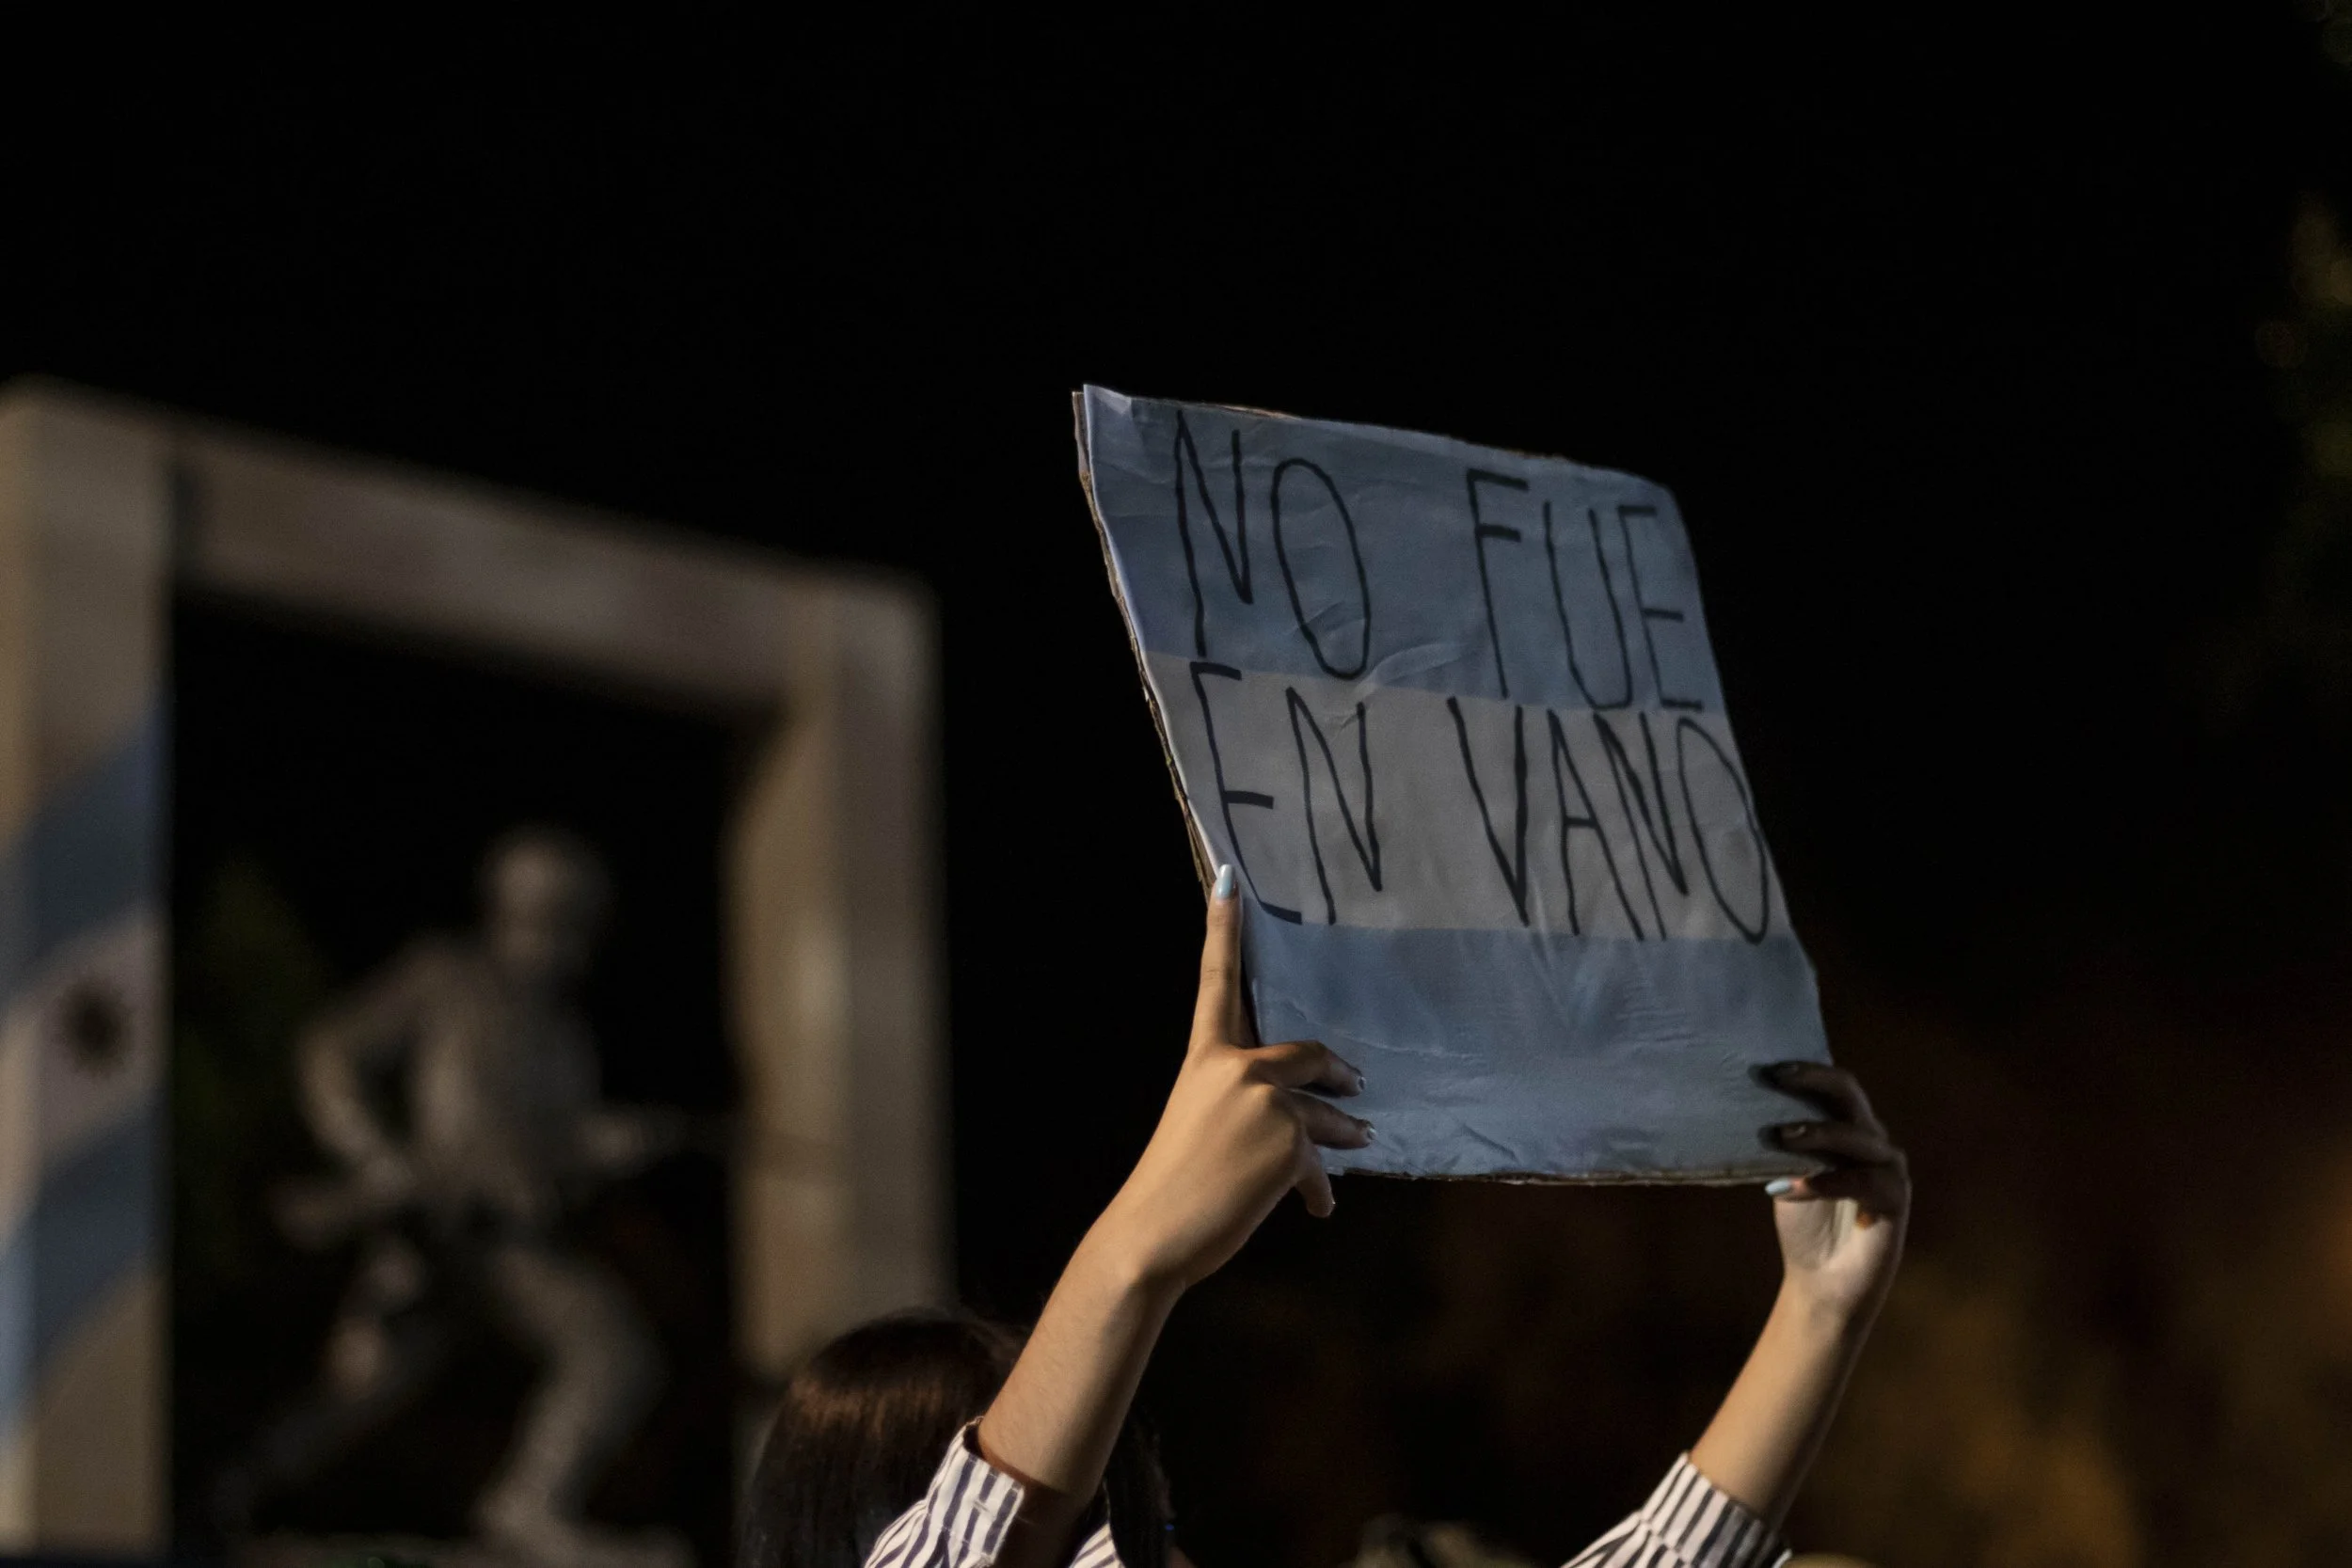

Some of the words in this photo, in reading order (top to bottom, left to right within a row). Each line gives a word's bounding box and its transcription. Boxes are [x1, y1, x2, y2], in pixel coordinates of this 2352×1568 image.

[1174, 409, 1372, 680] NO
[1466, 468, 1705, 713] FUE
[1189, 661, 1383, 926] EN
[1446, 695, 1769, 945] VANO
